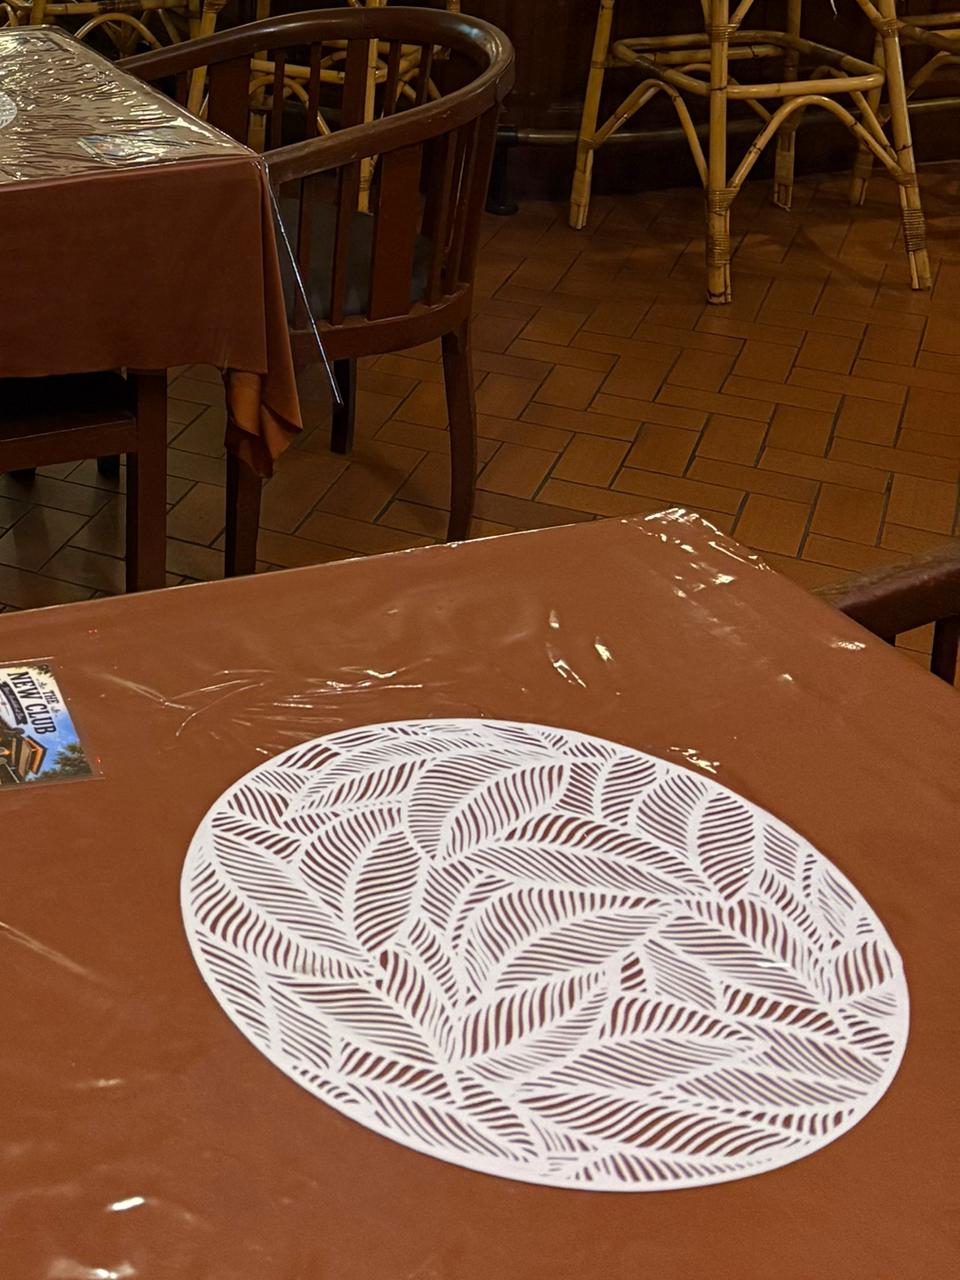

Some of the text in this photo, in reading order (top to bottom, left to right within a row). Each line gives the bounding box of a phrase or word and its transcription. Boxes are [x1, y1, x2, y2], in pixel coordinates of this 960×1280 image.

[7, 671, 43, 700] NEW
[25, 703, 56, 734] CLUB
[43, 690, 59, 704] THE
